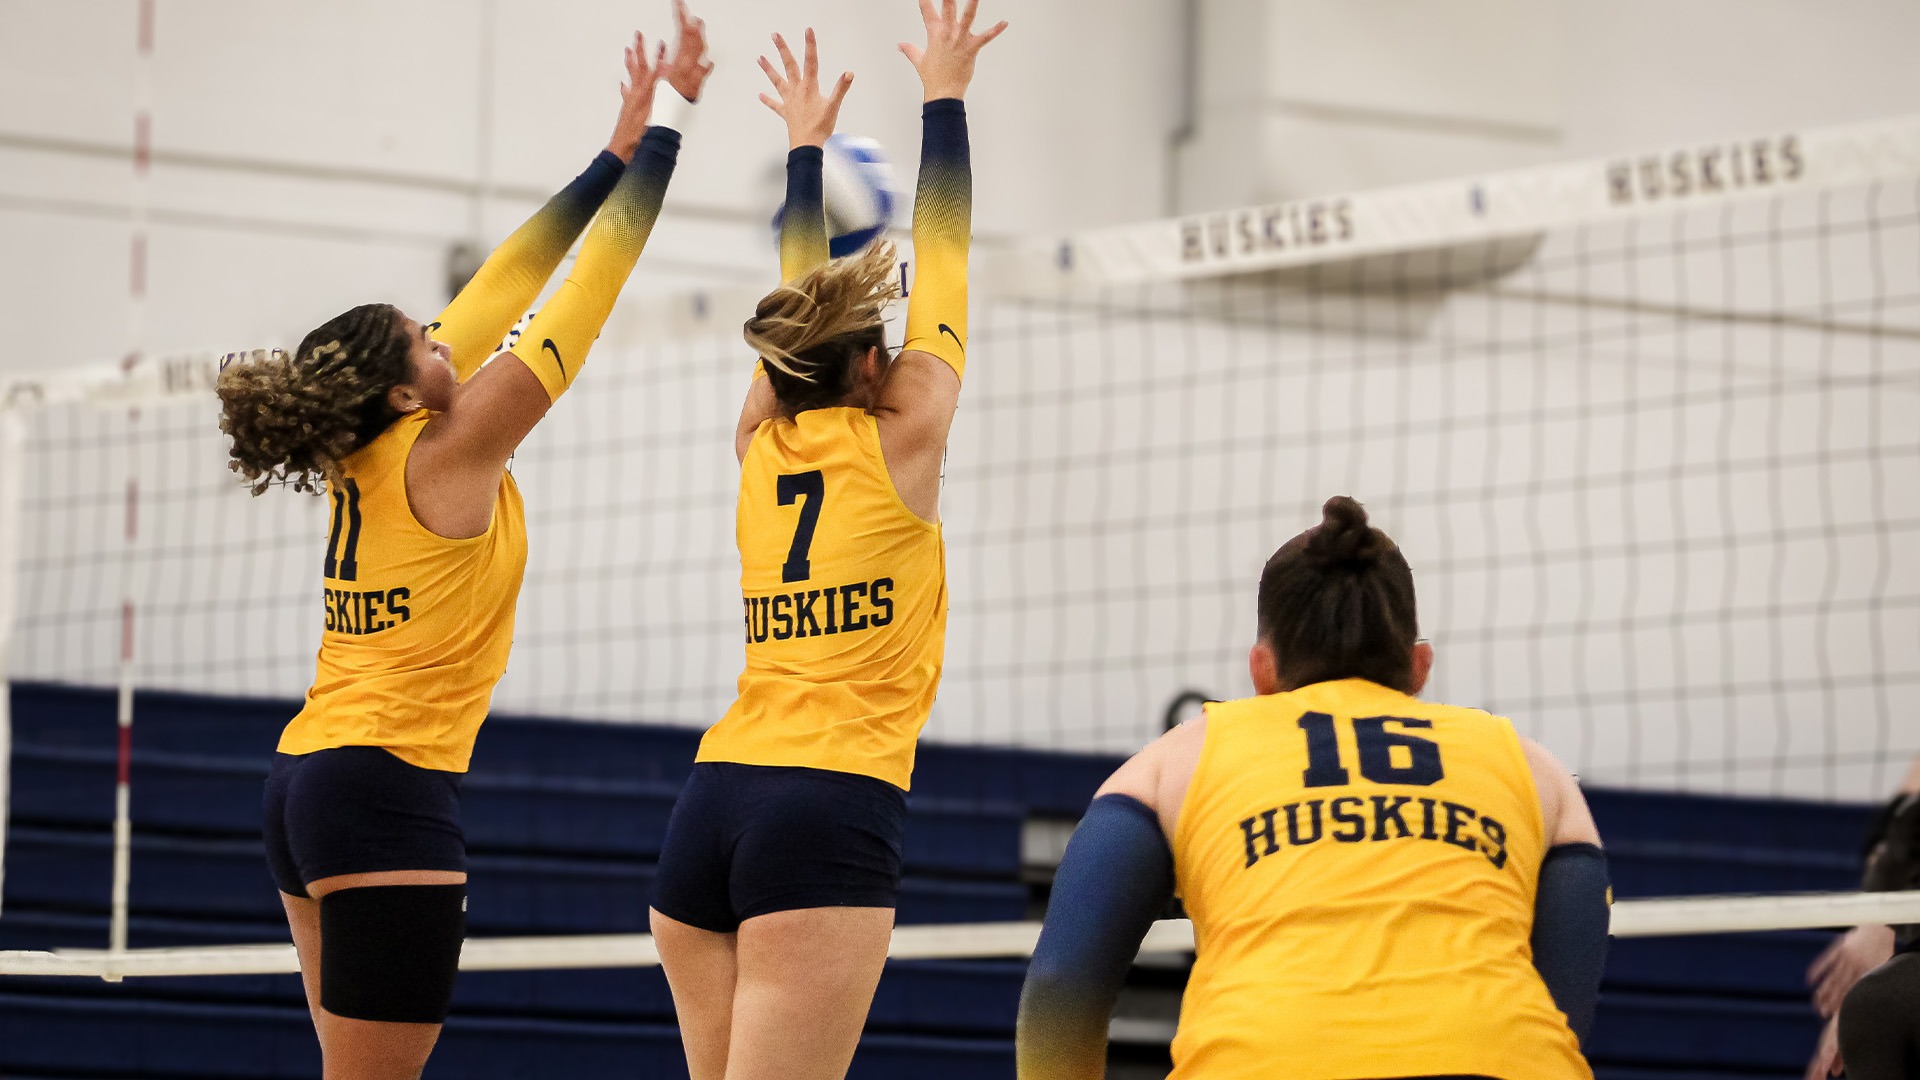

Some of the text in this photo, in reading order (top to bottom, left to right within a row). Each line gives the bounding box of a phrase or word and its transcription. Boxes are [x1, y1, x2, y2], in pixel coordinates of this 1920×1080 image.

[1606, 134, 1804, 206] HUSKIES
[1180, 200, 1354, 262] HUSKIES
[324, 478, 362, 581] 11
[777, 469, 824, 583] 7
[324, 586, 410, 635] SKIES
[1297, 711, 1444, 788] 16
[1239, 795, 1507, 869] HUSKIES
